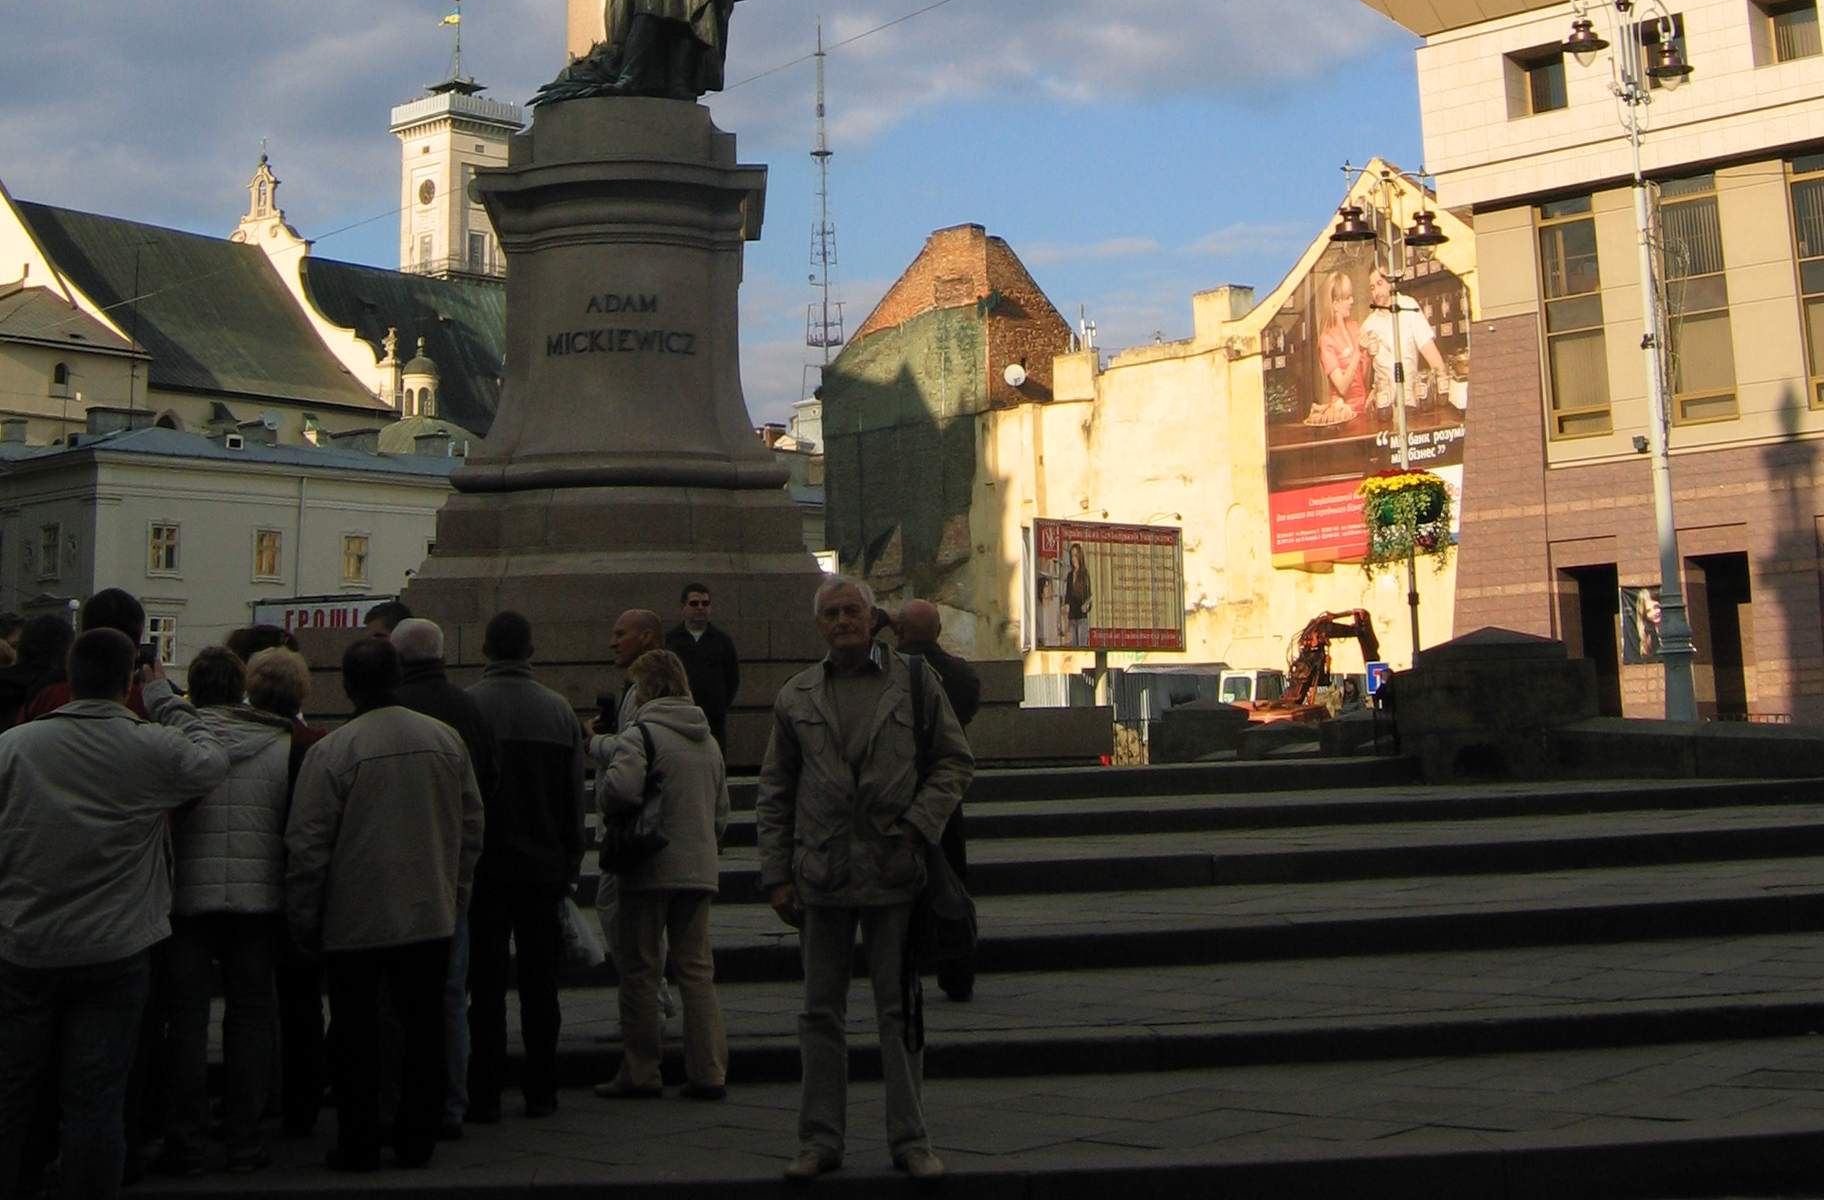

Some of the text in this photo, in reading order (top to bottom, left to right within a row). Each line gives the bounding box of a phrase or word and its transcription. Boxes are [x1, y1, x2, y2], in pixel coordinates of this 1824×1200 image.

[586, 294, 657, 313] ADAM
[547, 327, 697, 356] MICKIEWICZ
[1433, 424, 1466, 444] розумі
